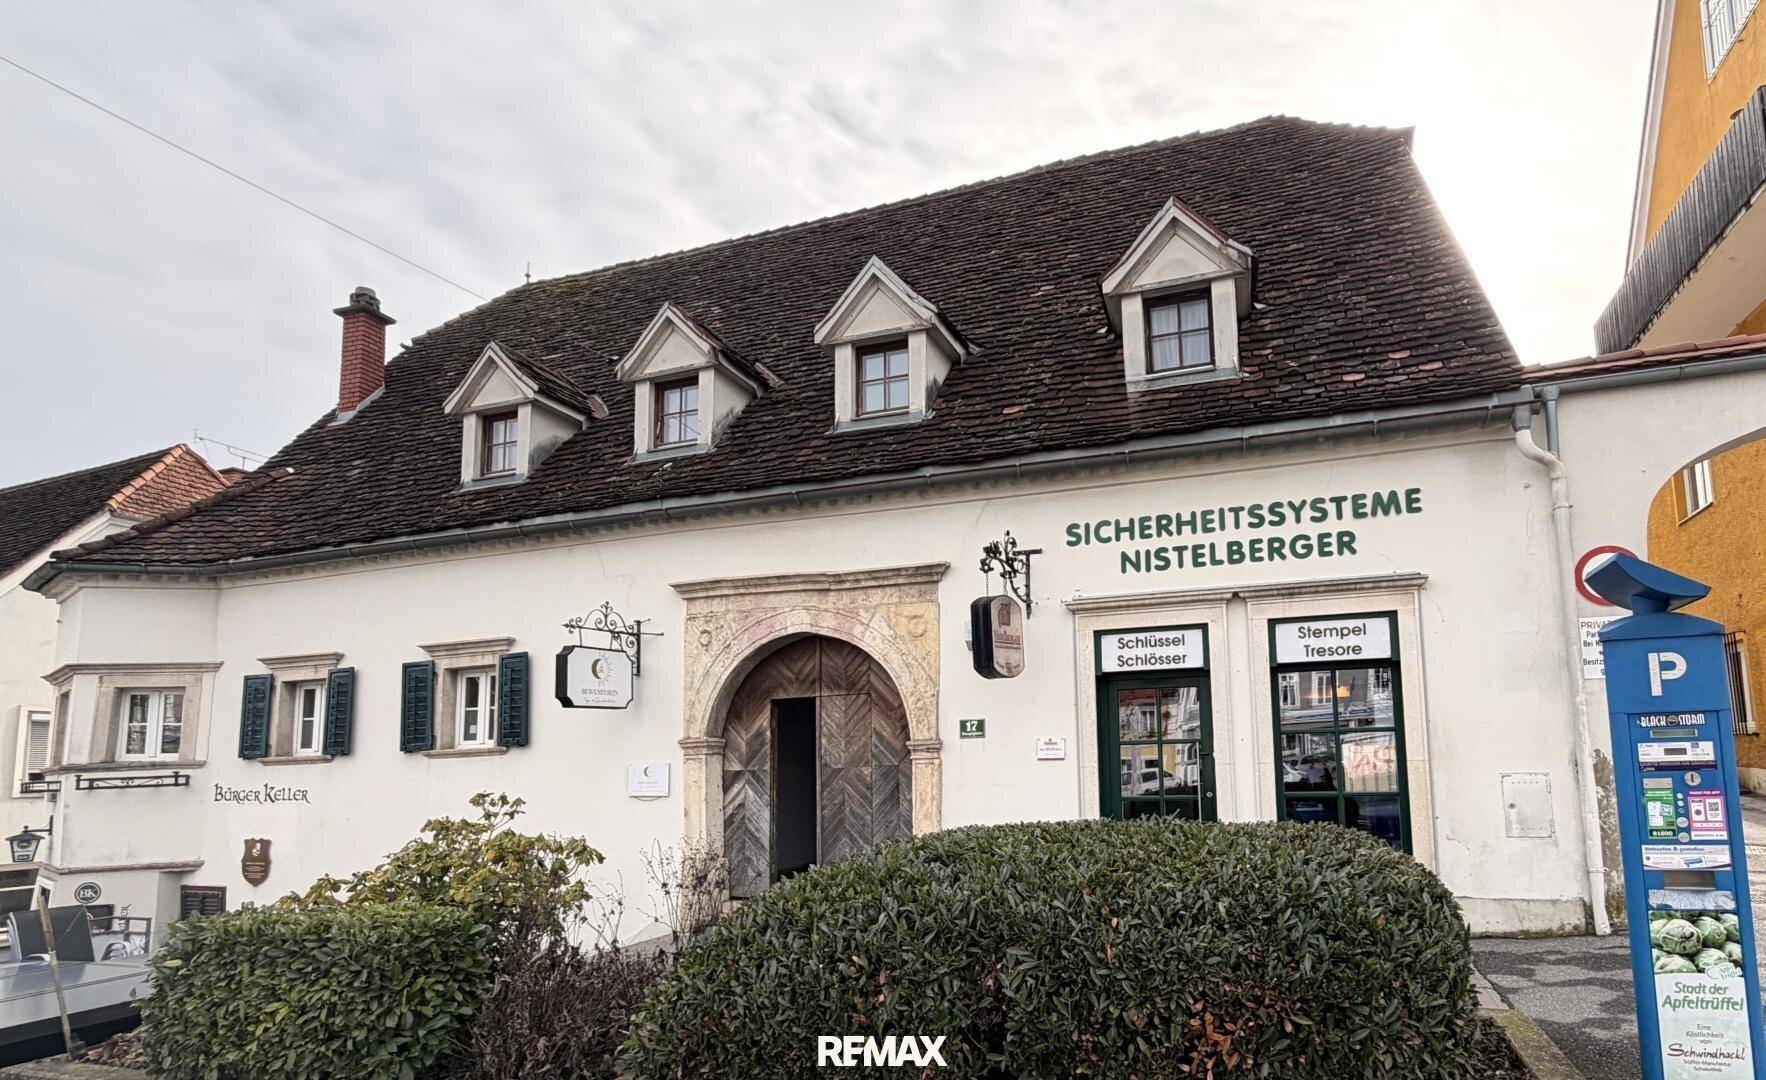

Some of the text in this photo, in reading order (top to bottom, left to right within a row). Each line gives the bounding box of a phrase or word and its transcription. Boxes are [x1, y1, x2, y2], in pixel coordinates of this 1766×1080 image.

[1065, 487, 1424, 548] SICHERHEITSSYSTEME
[1120, 530, 1358, 575] NISTELBERGER
[1297, 622, 1368, 641] Stempel
[1116, 633, 1186, 650] Schlüssel
[1303, 643, 1363, 659] Tresore
[1116, 652, 1188, 668] Schlösser
[1648, 651, 1688, 697] P
[965, 720, 978, 732] 17
[1640, 713, 1705, 727] BLACK STORM
[1673, 981, 1729, 995] Stadt der
[1661, 995, 1745, 1011] Apfeltrüffel
[1667, 1042, 1745, 1061] Schwindhackl
